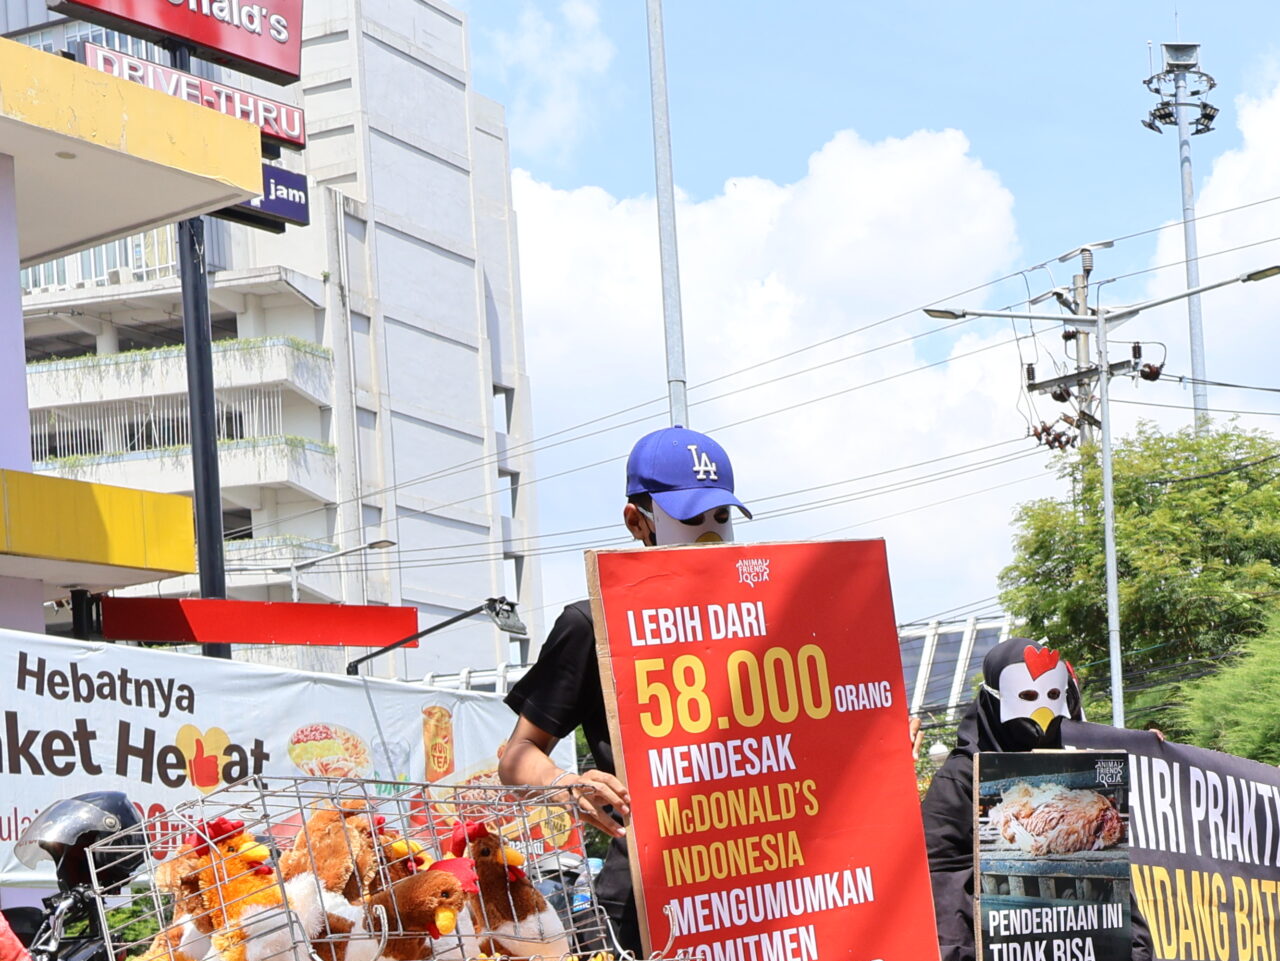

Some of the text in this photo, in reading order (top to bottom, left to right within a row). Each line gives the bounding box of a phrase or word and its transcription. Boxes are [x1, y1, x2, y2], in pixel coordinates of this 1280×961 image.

[166, 0, 289, 43] nald's
[97, 50, 300, 138] DRIVE-THRU
[269, 178, 306, 205] jam
[687, 444, 718, 480] LA
[627, 601, 767, 647] LEBIH DARI
[17, 651, 196, 718] Hebatnya
[634, 644, 892, 738] 58.000 ORANG
[0, 711, 104, 777] ket
[648, 733, 796, 788] MENDESAK
[655, 779, 819, 838] McDONALD'S
[1129, 753, 1187, 854] HIRI
[662, 830, 805, 887] INDONESIA
[669, 866, 875, 937] MENGUMUMKAN
[989, 903, 1123, 937] PENDERITAAN INI
